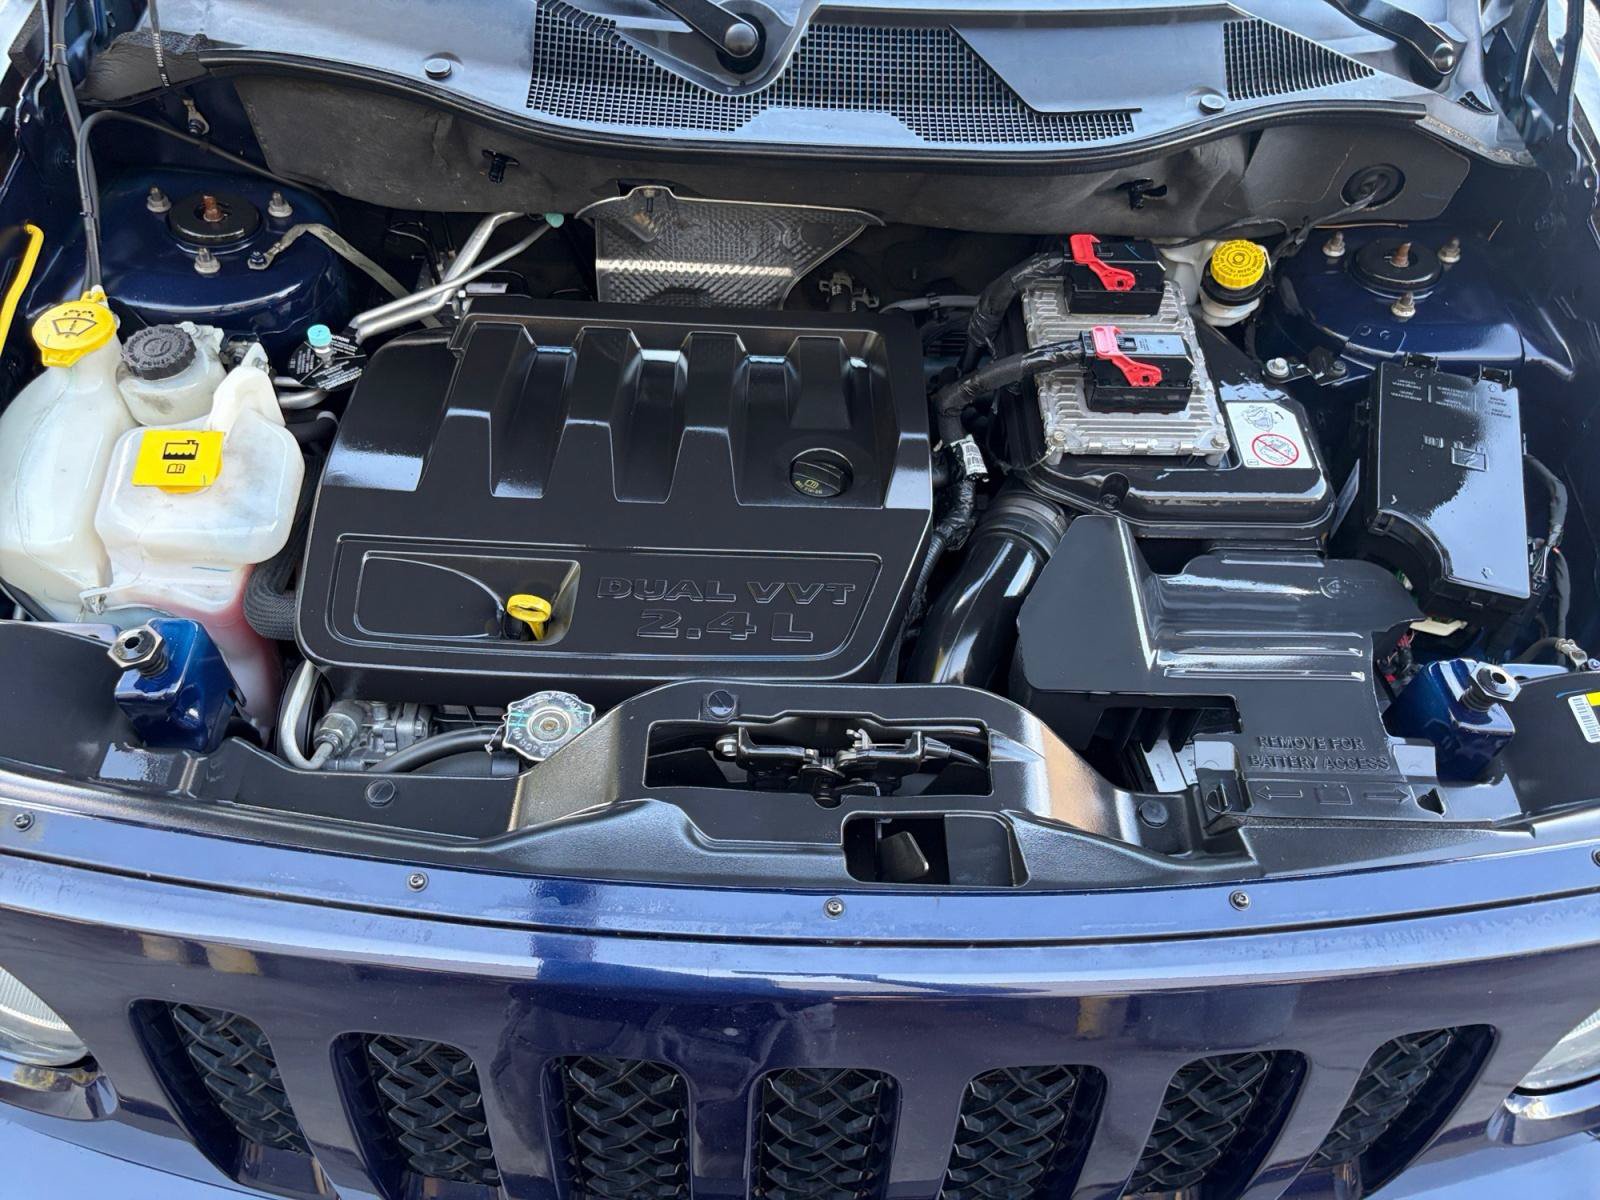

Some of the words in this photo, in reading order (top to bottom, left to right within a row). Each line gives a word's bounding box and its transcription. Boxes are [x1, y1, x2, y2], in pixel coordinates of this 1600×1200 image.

[597, 577, 736, 602] DUAL
[747, 582, 856, 604] VVT
[636, 609, 757, 640] 2.4
[771, 613, 813, 641] L
[1257, 735, 1327, 751] REMOVE
[1330, 737, 1366, 750] FOR
[1248, 753, 1318, 769] BATTERY
[1323, 756, 1390, 771] ACCESS
